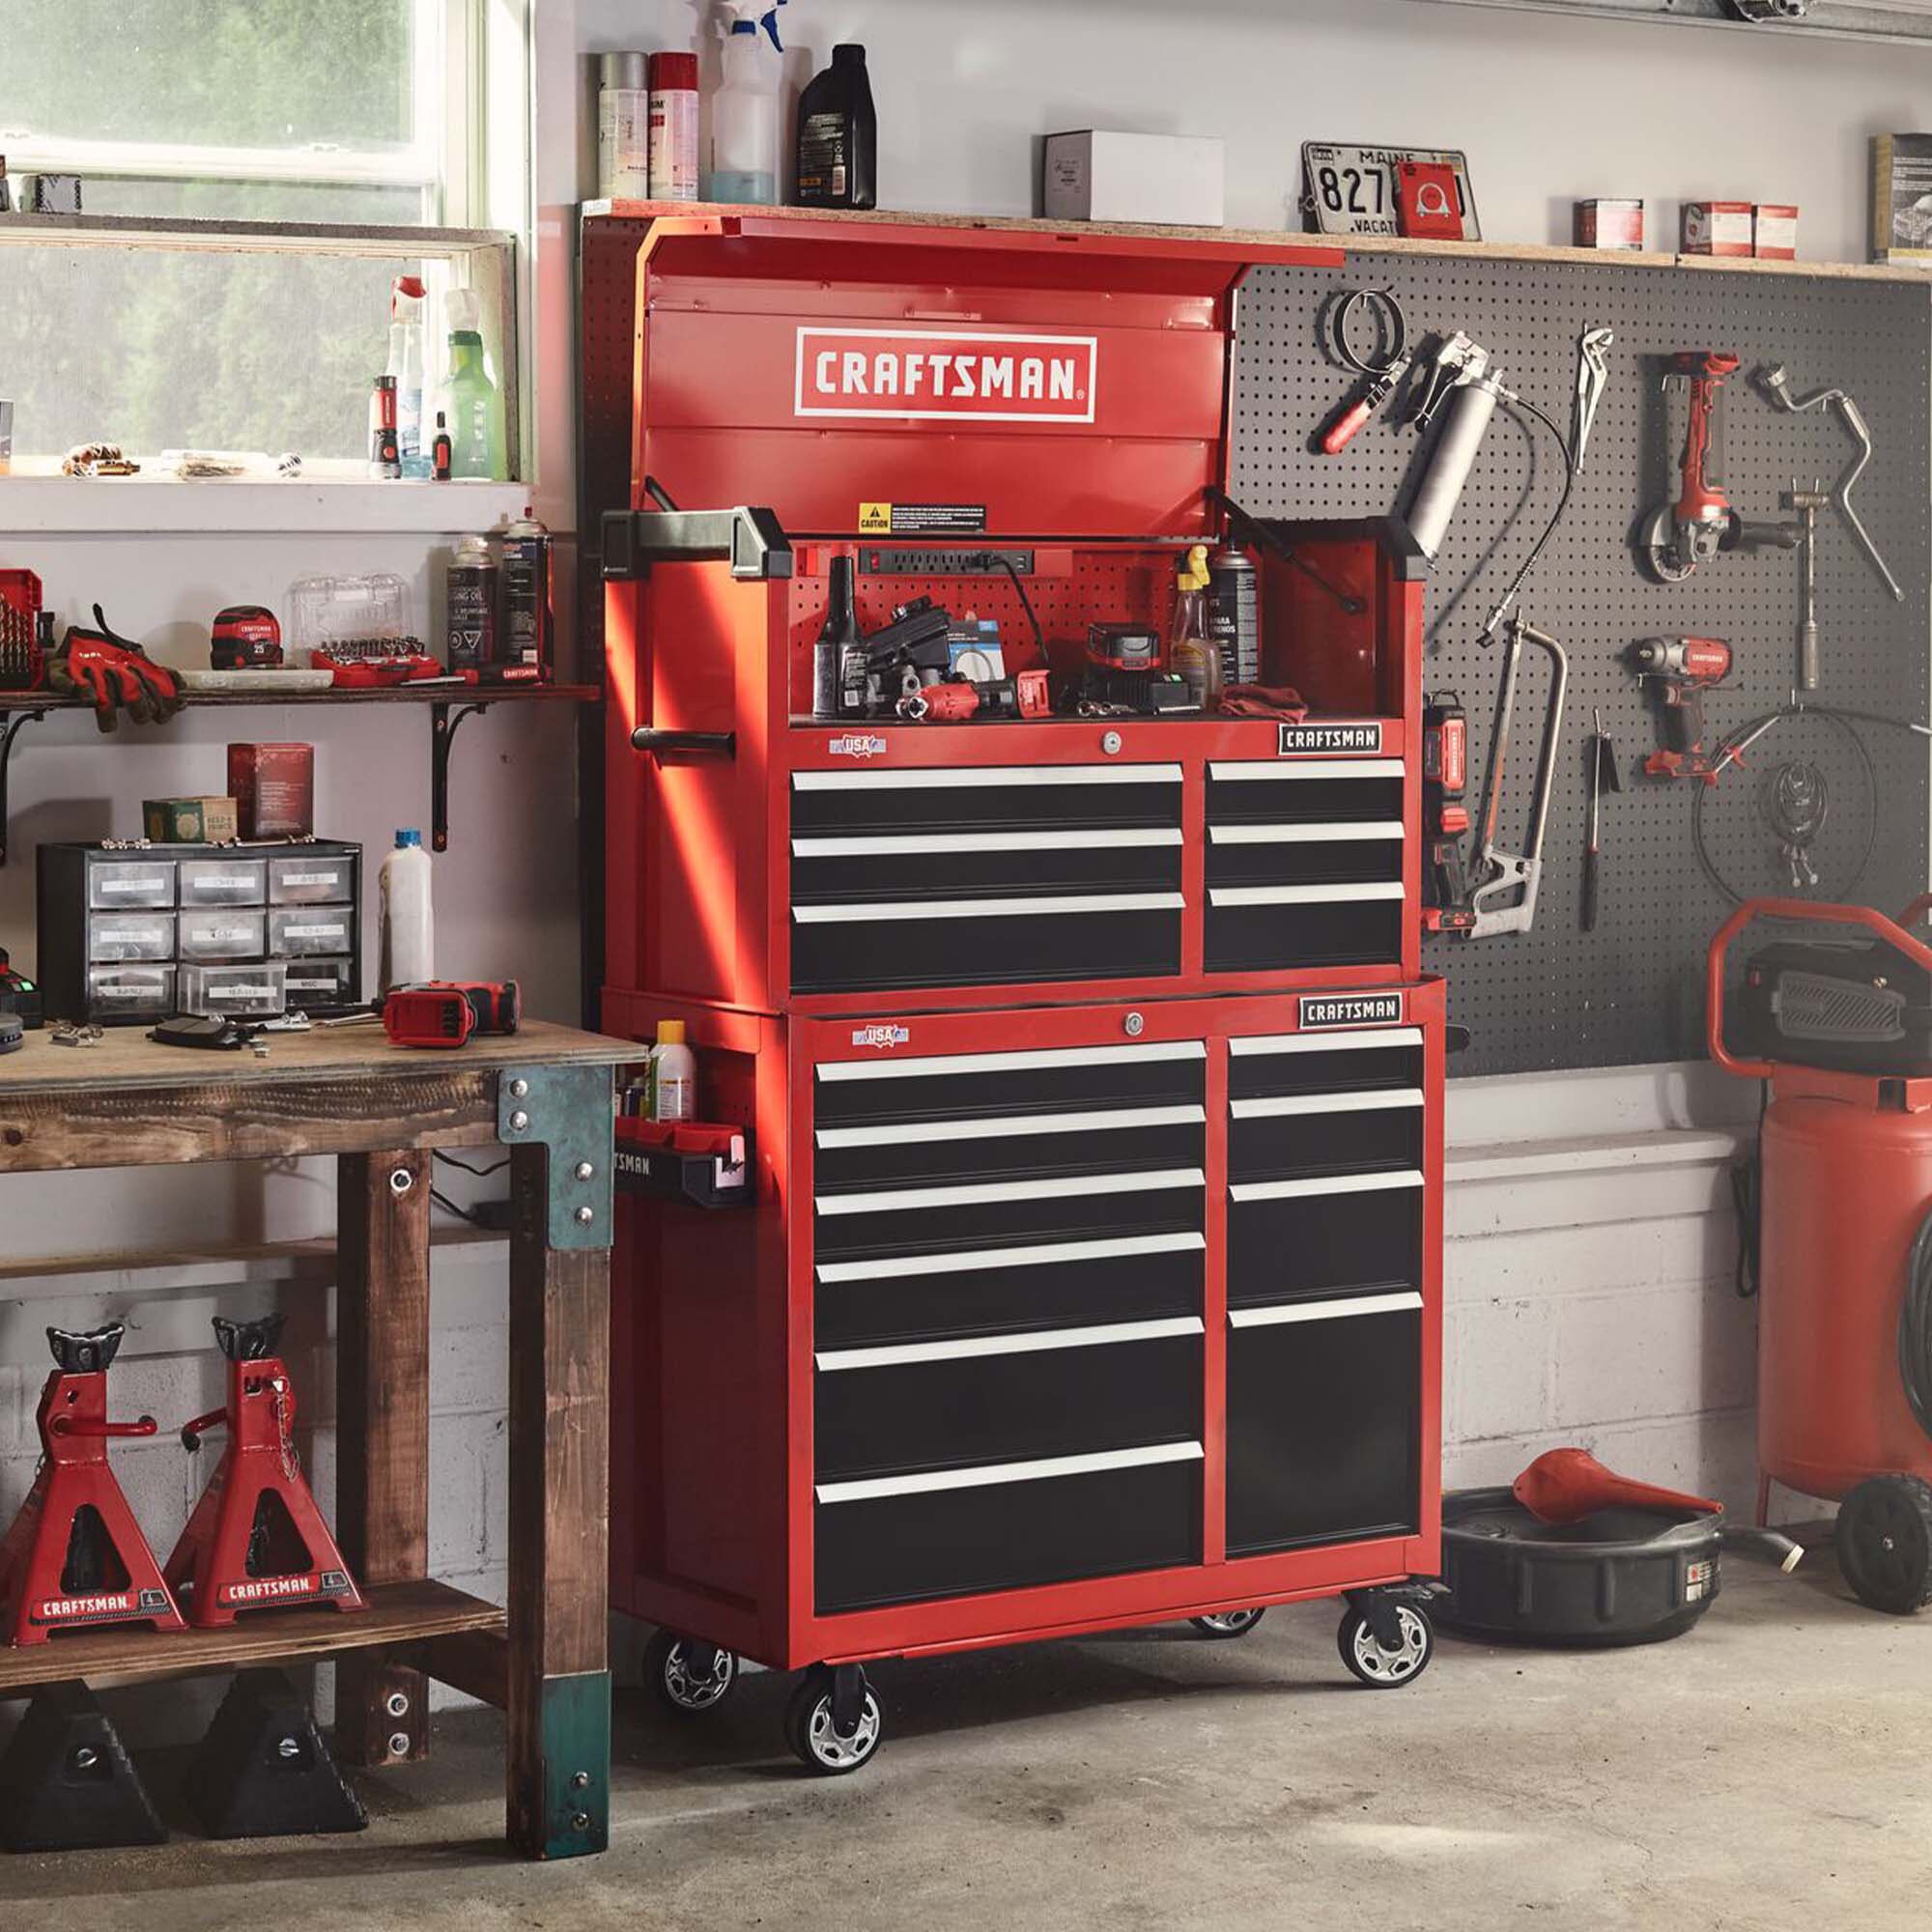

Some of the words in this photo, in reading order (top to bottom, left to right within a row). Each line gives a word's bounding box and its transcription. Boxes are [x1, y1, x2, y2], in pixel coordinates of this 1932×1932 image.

[1359, 150, 1414, 165] MAINE
[1319, 167, 1400, 214] 827
[1353, 219, 1395, 234] VACAT
[816, 351, 1075, 400] CRAFTSMAN
[861, 519, 889, 528] CAUTION
[845, 738, 870, 752] USA
[1286, 729, 1376, 748] CRAFTSMAN
[1307, 1000, 1396, 1021] CRAFTSMAN
[867, 1027, 894, 1042] USA
[613, 1152, 649, 1176] TSMAN
[229, 1577, 310, 1599] CRAFTSMAN
[43, 1595, 128, 1616] CRAFTSMAN
